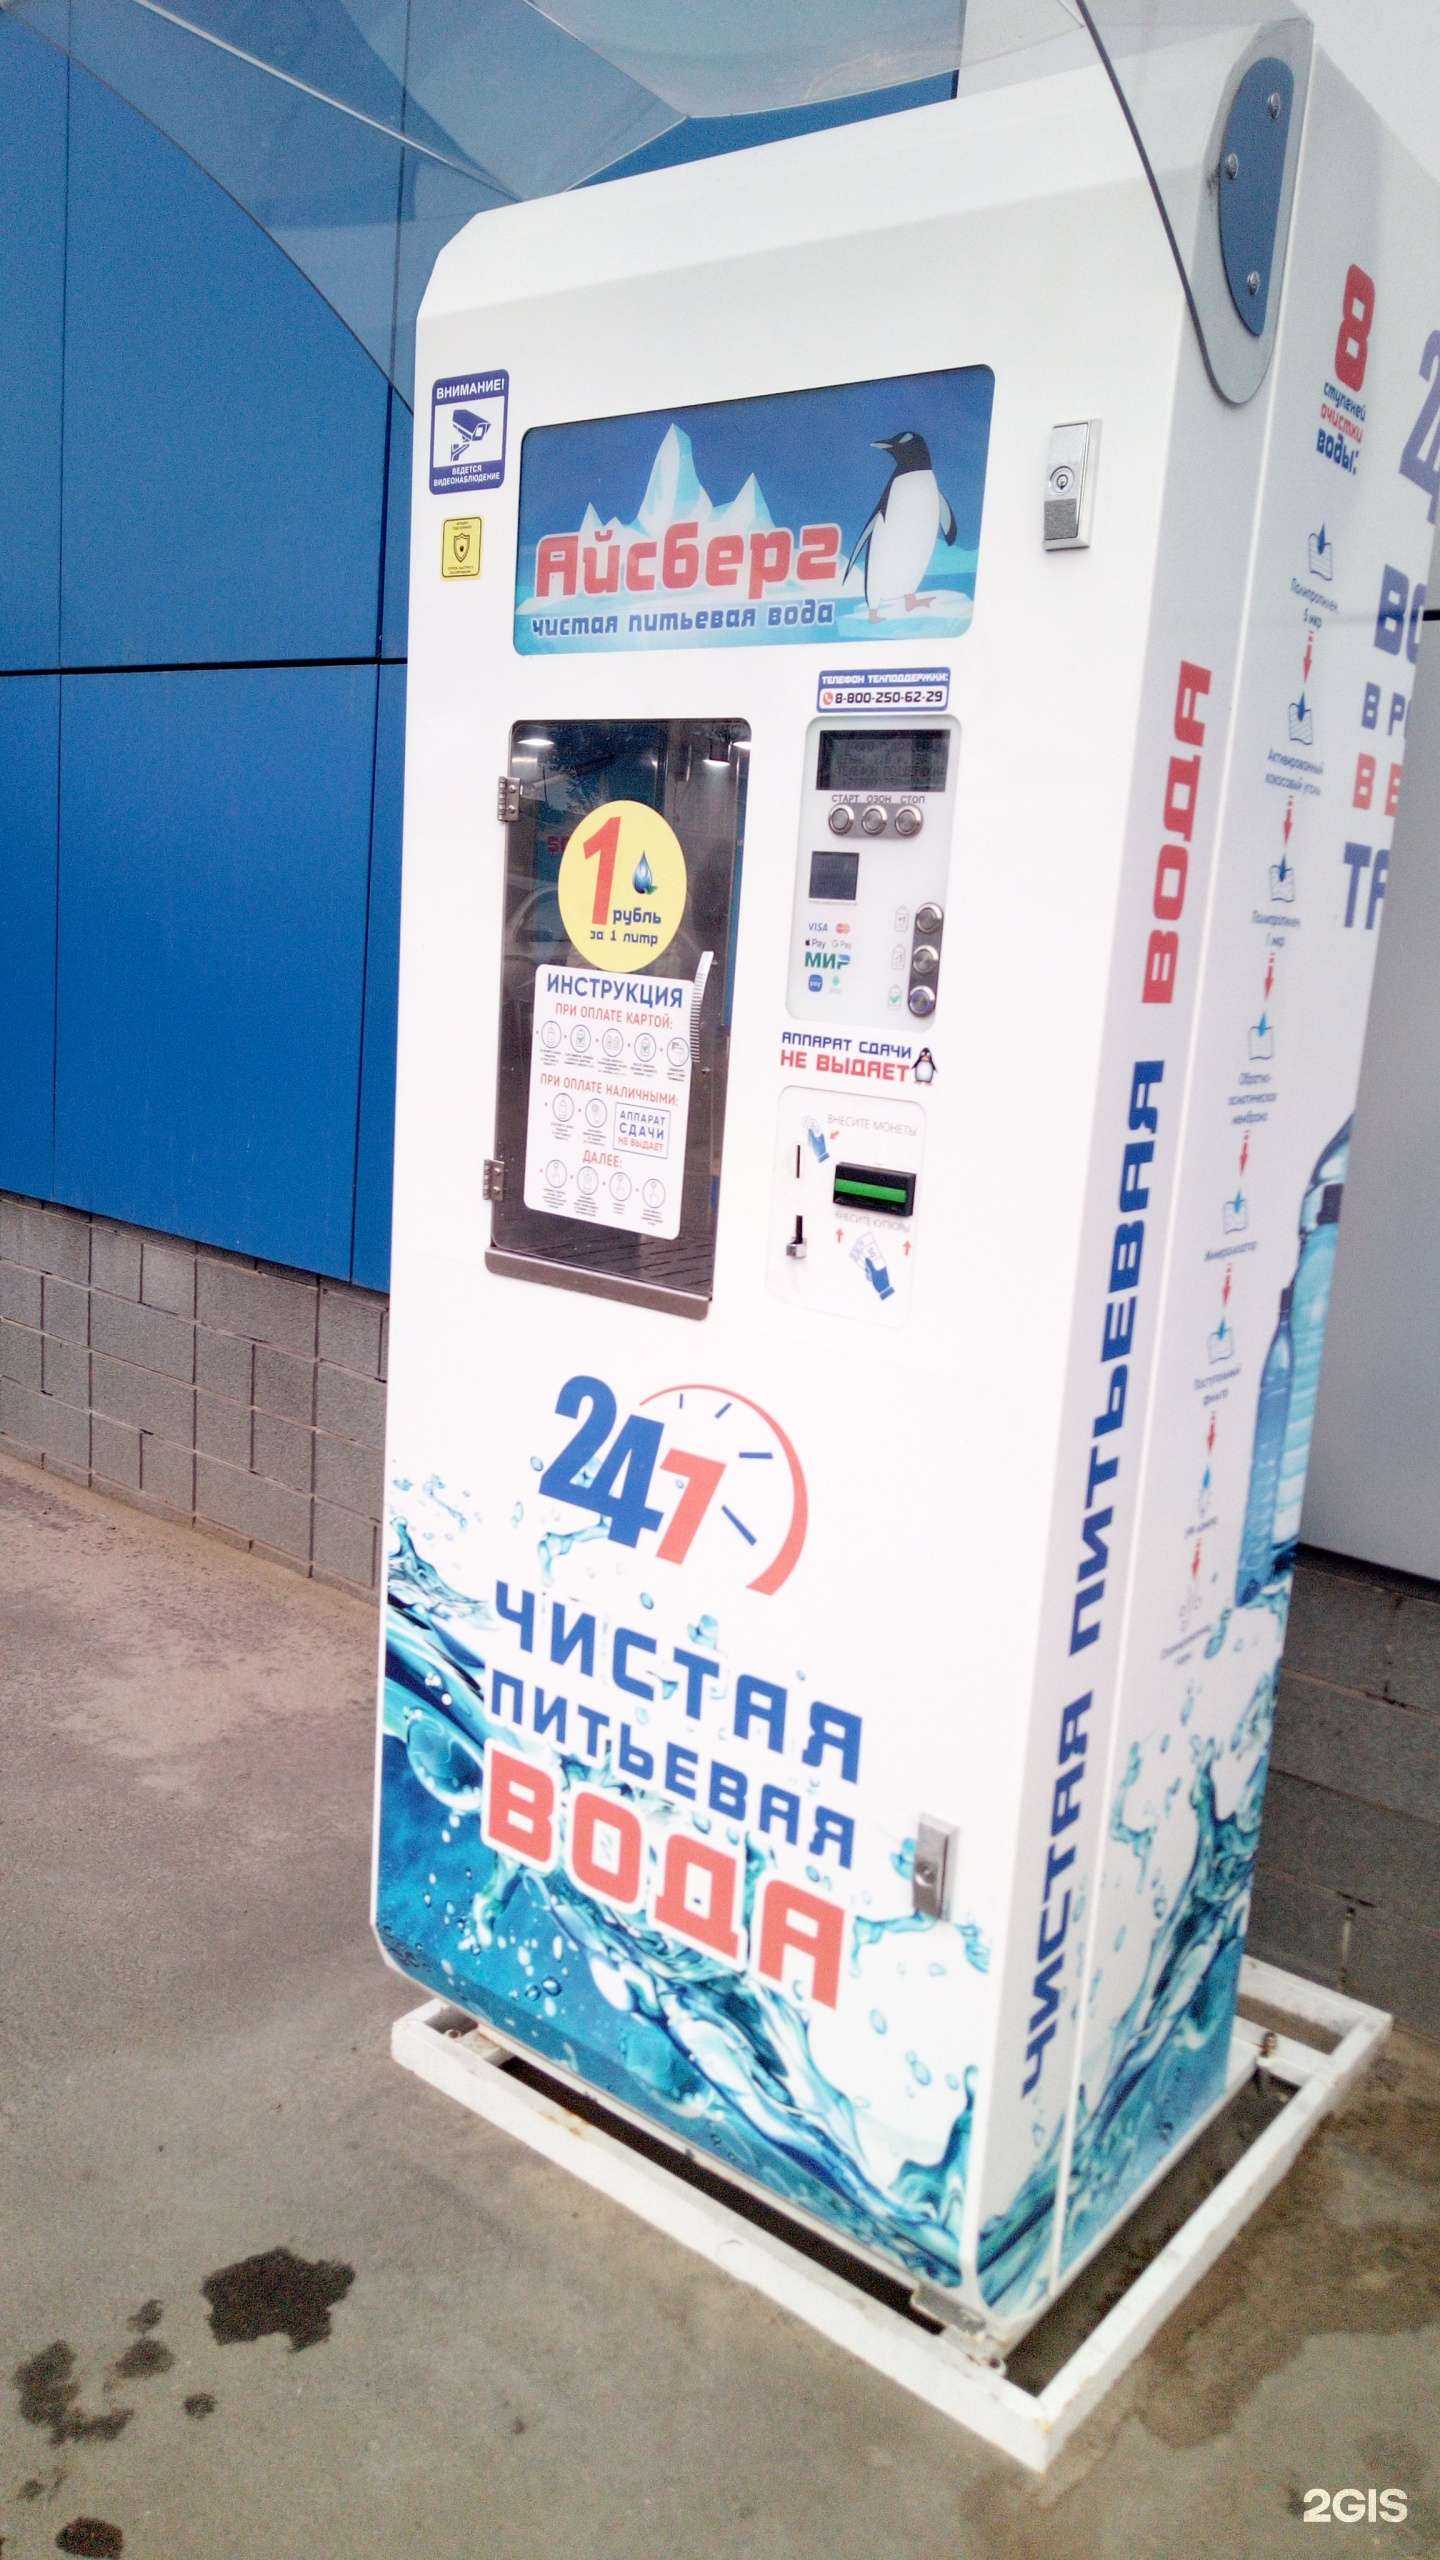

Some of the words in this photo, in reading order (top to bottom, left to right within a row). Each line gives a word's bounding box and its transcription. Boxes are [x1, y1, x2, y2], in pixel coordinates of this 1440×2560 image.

[1334, 264, 1375, 391] 8
[436, 378, 505, 400] ВНИМАНИЕ!
[1324, 382, 1367, 422] ступеней
[1320, 403, 1364, 444] очистки
[433, 471, 501, 487] ВИДЕОНАБЛЮДЕНИЕ
[451, 464, 483, 475] ВЕДЕТСЯ
[535, 522, 840, 600] Айсберг
[532, 614, 619, 637] чистая
[628, 607, 757, 634] питьевая
[767, 600, 834, 626] вода
[821, 675, 865, 685] ТЕЛЕФОН
[834, 690, 944, 705] 8-800-250-62-29
[831, 794, 861, 803] СТАРТ
[867, 795, 892, 804] ОЗОН
[900, 795, 926, 804] СТОП
[583, 816, 621, 926] 1
[613, 908, 662, 926] рубль
[808, 922, 829, 932] VISA
[590, 931, 604, 941] за
[610, 931, 617, 941] 1
[623, 933, 659, 947] литр
[804, 951, 851, 970] МИР
[547, 973, 684, 1008] ИНСТРУКЦИЯ
[555, 1002, 577, 1017] ПРИ
[581, 1006, 623, 1023] ОПЛАТЕ
[626, 1012, 673, 1030] КАРТОЙ:
[782, 1031, 852, 1051] АППАРАТ
[859, 1041, 912, 1060] СДАЧИ
[780, 1050, 807, 1069] НЕ
[816, 1053, 910, 1083] ВЫДАЕТ
[540, 1073, 561, 1086] ПРИ
[564, 1076, 603, 1094] ОПЛАТЕ
[606, 1084, 679, 1106] НАЛИЧНЫМИ:
[619, 1110, 666, 1126] АППАРАТ
[619, 1121, 665, 1140] СДАЧИ
[618, 1137, 630, 1147] НЕ
[631, 1139, 664, 1151] ВЫДАЕТ
[582, 1149, 623, 1168] ДАЛЕЕ:
[1022, 1690, 1093, 2099] ЧИСТАЯ
[1069, 1059, 1166, 1656] ПИТЬЕВАЯ
[1141, 660, 1213, 1004] ВОДА
[496, 1580, 863, 1785] ЧИСТАЯ
[491, 1669, 855, 1870] ПИТЬЕВАЯ
[487, 1748, 845, 2012] ВОДА
